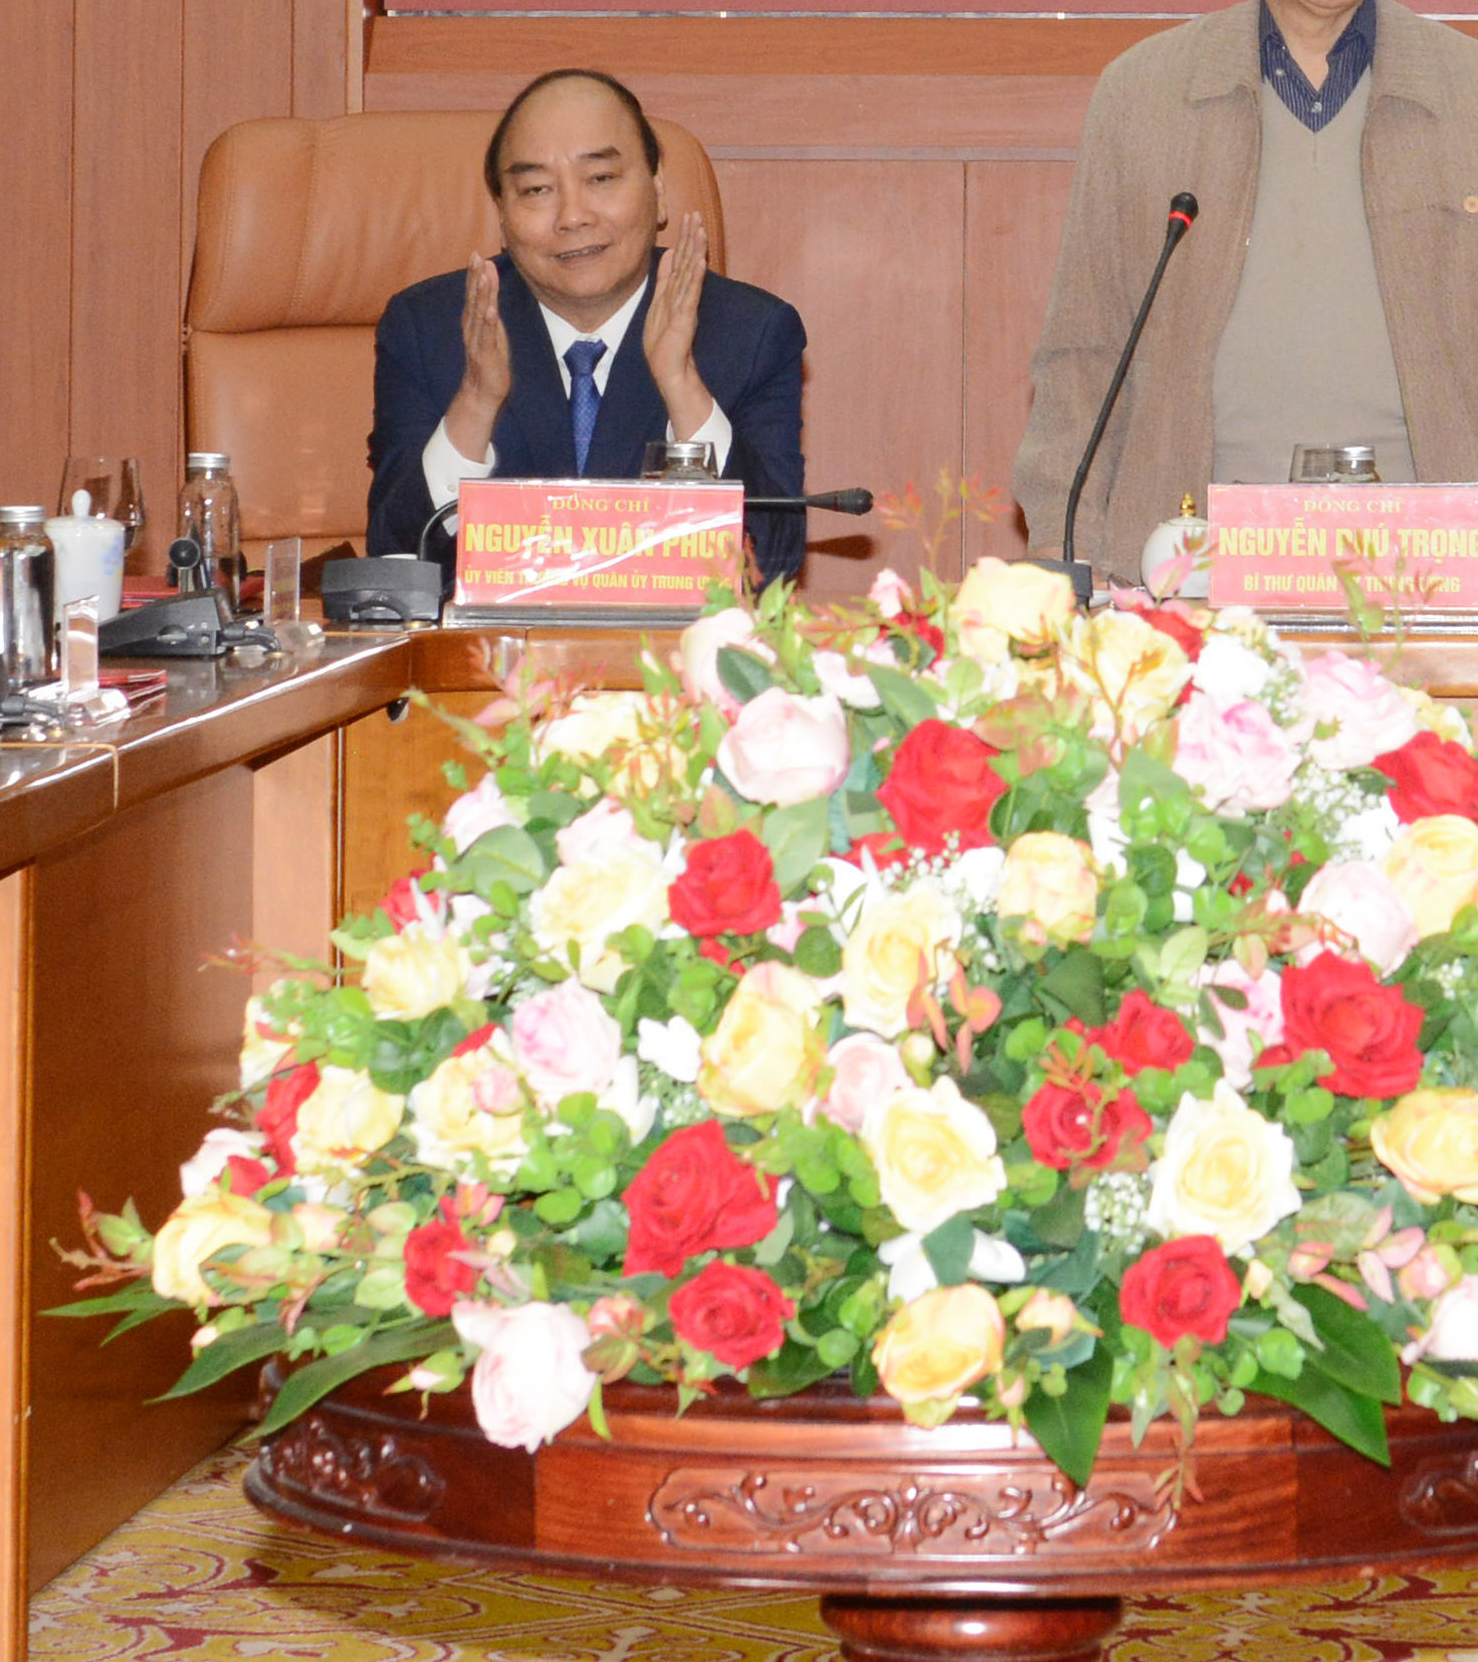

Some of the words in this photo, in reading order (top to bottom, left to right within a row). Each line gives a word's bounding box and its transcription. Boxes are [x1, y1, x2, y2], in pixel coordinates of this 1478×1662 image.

[615, 497, 650, 512] CHÍ
[465, 514, 573, 555] NGUYỄN
[1219, 517, 1327, 557] NGUYỄN
[486, 568, 514, 585] VIÊN
[593, 572, 628, 589] QUÂN
[652, 574, 693, 589] TRUNG
